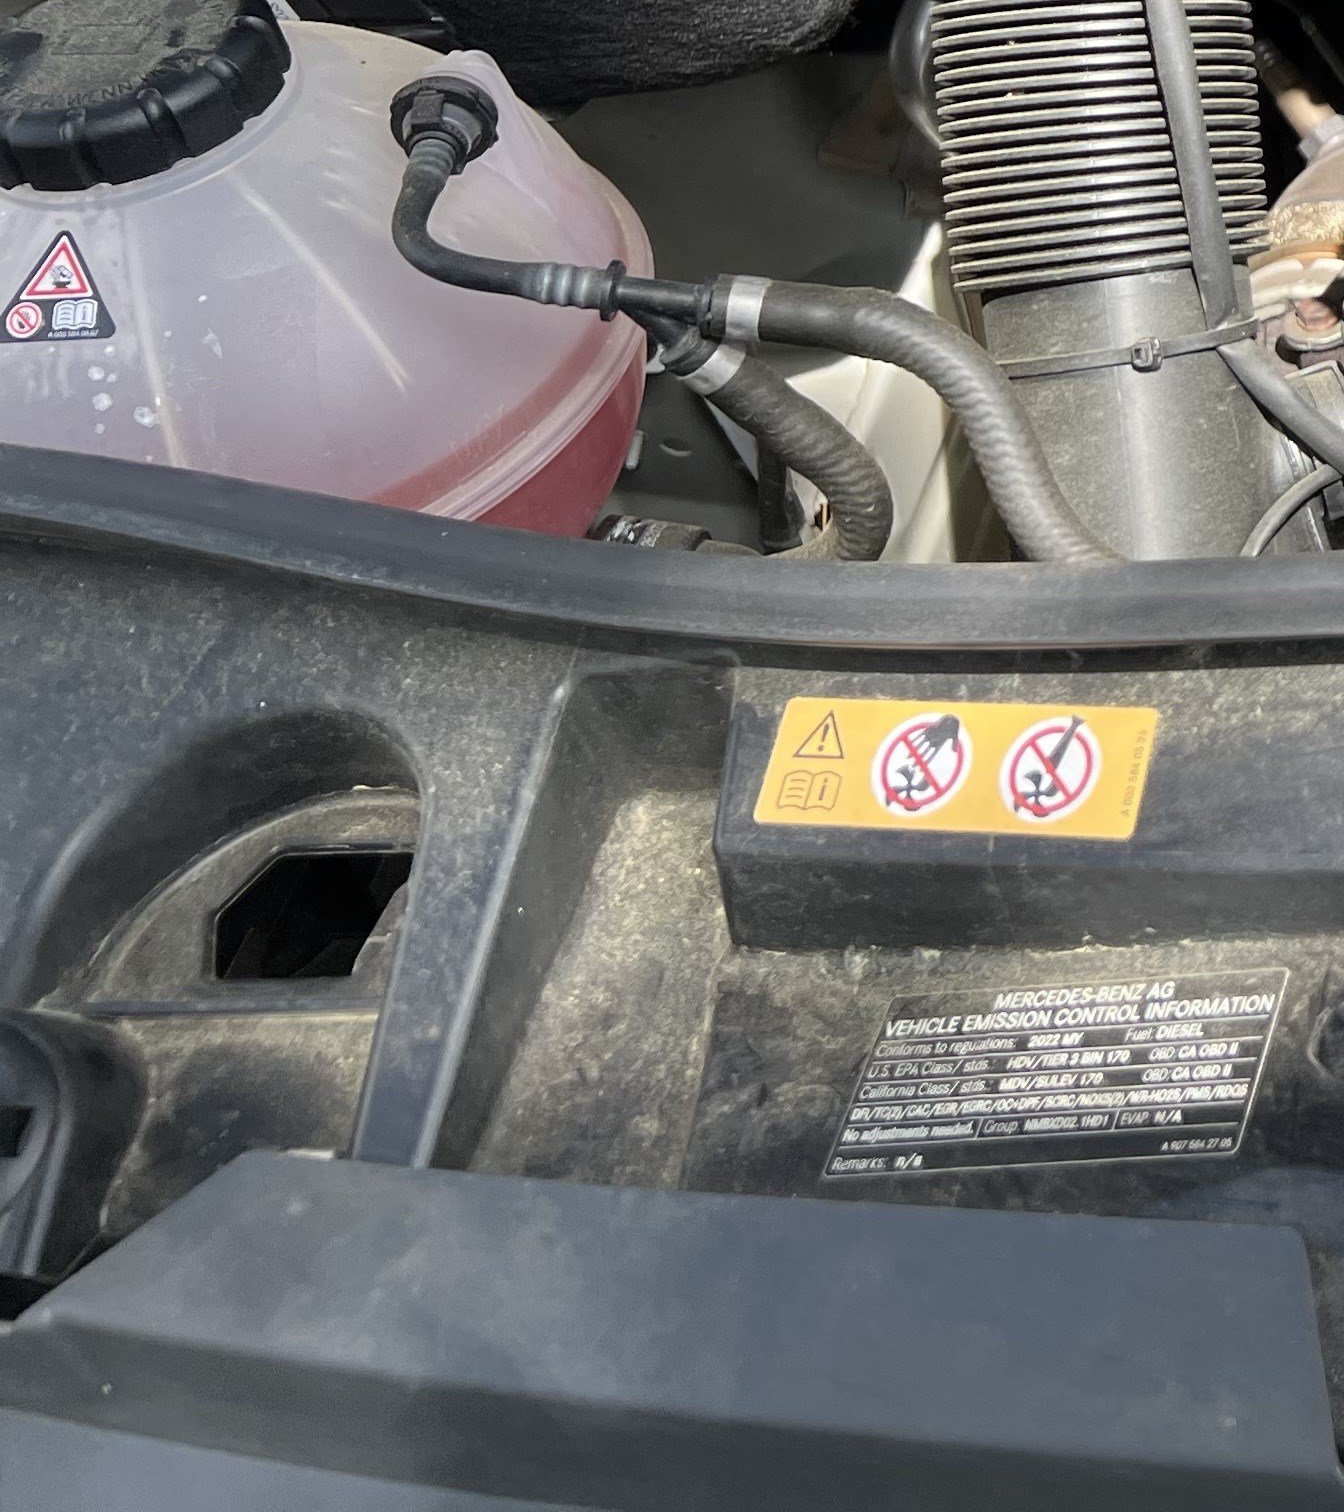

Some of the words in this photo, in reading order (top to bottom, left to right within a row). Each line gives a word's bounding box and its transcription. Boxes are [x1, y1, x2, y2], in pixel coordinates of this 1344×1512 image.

[994, 982, 1146, 1010] MERCEDES-BENZ
[1147, 980, 1176, 999] AG
[883, 1015, 961, 1038] VEHICLE
[962, 1009, 1051, 1033] EMISSION
[1054, 1002, 1143, 1027] CONTROL
[1144, 993, 1275, 1021] INFORMATION
[1155, 1023, 1205, 1040] DIESEL
[876, 1041, 933, 1058] Conforms
[935, 1041, 948, 1054] to
[1029, 1033, 1061, 1048] 2022
[1178, 1044, 1197, 1059] CA
[1199, 1042, 1227, 1058] OBD
[867, 1064, 892, 1079] U.S.
[895, 1062, 920, 1077] EPA
[921, 1059, 961, 1075] Class/
[1106, 1049, 1131, 1063] 170
[1171, 1066, 1191, 1081] CA
[1193, 1064, 1221, 1079] OBD
[859, 1082, 917, 1100] California
[917, 1080, 958, 1096] Class/
[1080, 1071, 1104, 1086] 170
[1154, 1109, 1184, 1124] N/A
[843, 1128, 860, 1142] No
[861, 1123, 929, 1143] adjustments
[931, 1121, 975, 1137] needed.
